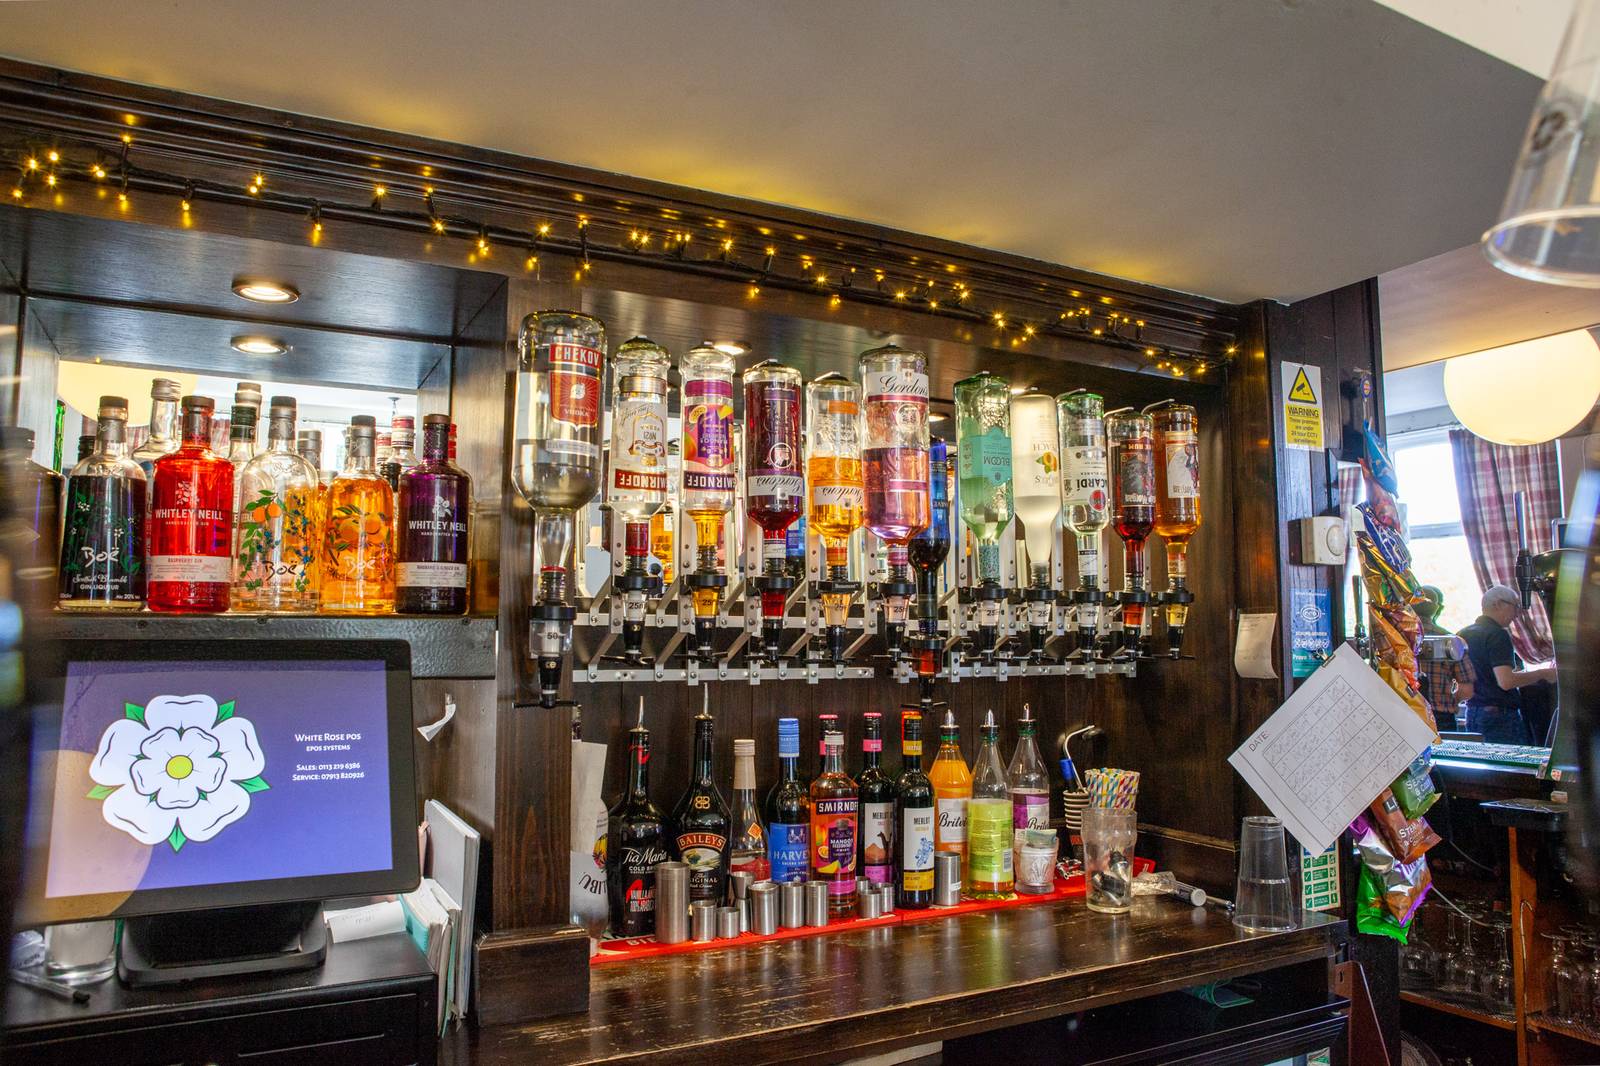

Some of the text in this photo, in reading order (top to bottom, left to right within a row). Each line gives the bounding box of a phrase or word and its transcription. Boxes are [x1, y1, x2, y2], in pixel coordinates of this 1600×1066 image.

[554, 347, 600, 367] CHEKOV
[1288, 406, 1320, 418] WARNING
[983, 456, 1010, 467] BLOOM
[155, 508, 224, 521] WHITLEY NEILL
[408, 520, 467, 533] WHITLEY NEILL
[80, 546, 120, 569] Boë
[264, 560, 298, 581] Boë
[345, 762, 360, 770] 6386
[679, 835, 724, 847] BAILEYS
[621, 847, 667, 866] Tia Maria
